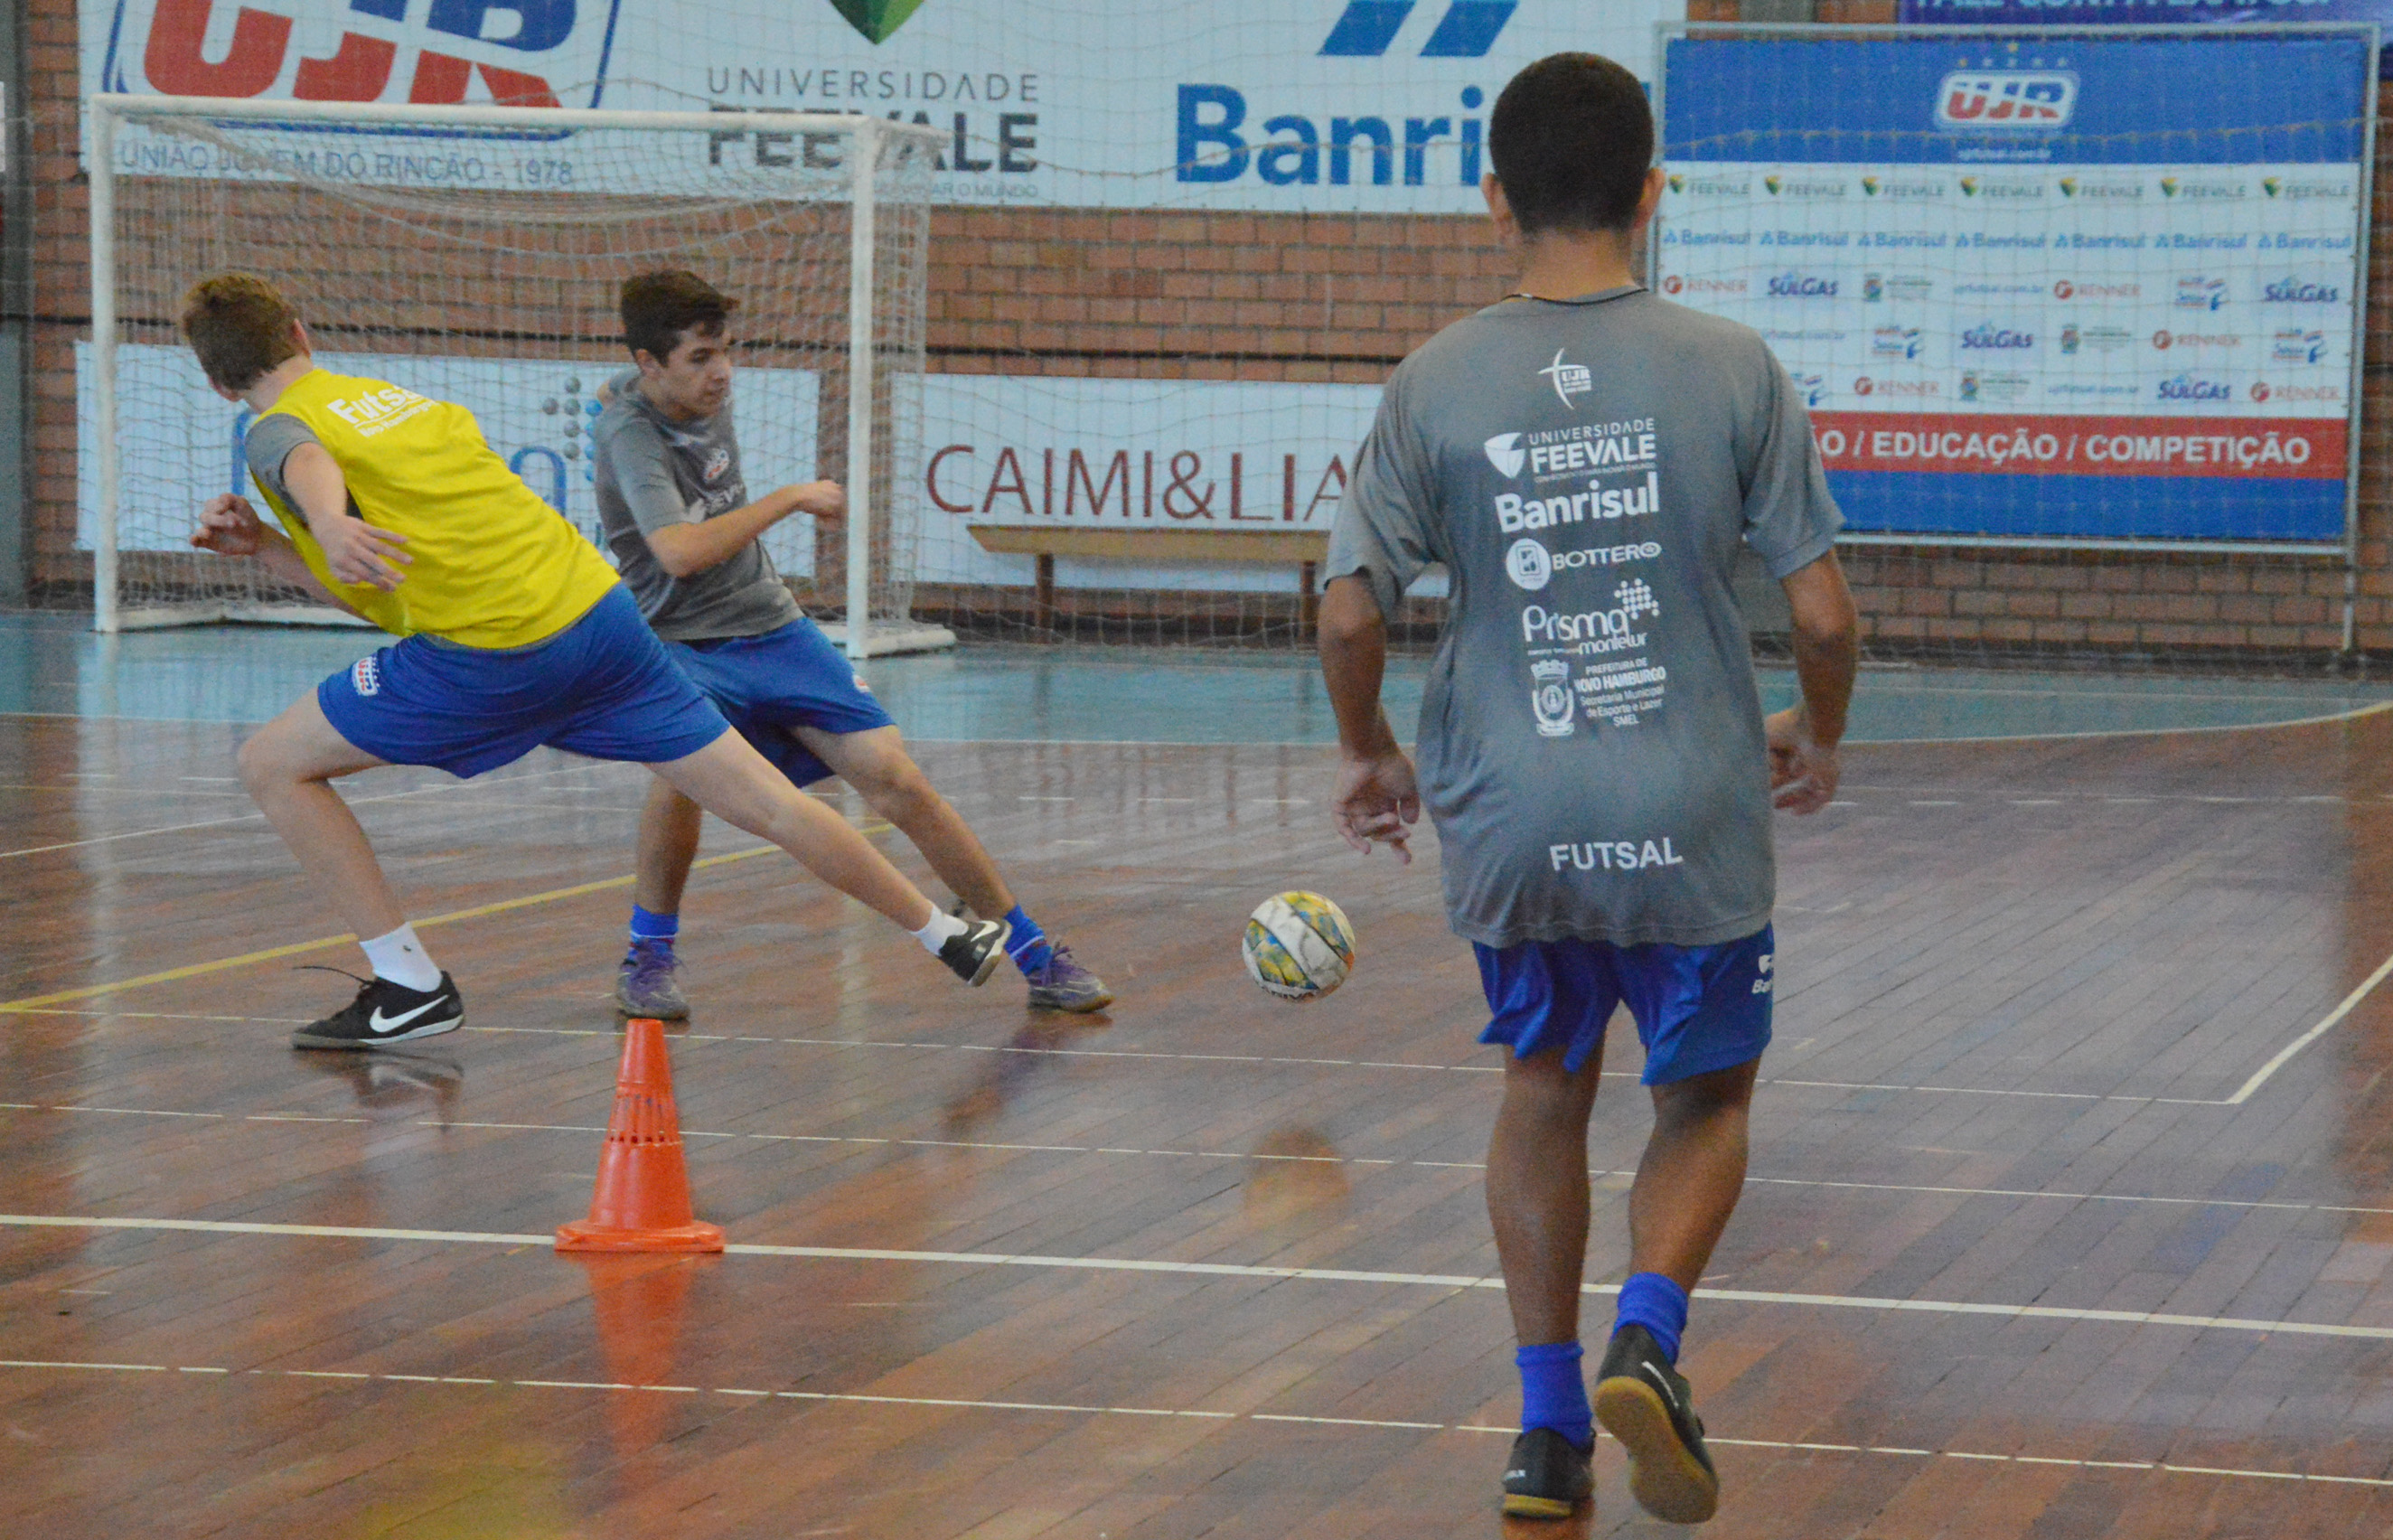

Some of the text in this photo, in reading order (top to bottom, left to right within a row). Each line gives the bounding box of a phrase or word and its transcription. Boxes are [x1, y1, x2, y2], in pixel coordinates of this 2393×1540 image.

[144, 0, 577, 108] UJR
[707, 67, 1039, 102] UNIVERSIDADE
[1947, 79, 2066, 119] UJR
[709, 103, 1039, 173] FEEALE
[1177, 82, 1485, 186] Banri
[324, 152, 367, 179] DO
[515, 158, 573, 183] 1978
[1681, 229, 1751, 245] Banrisul
[1777, 230, 1849, 247] Banrisul
[1874, 231, 1947, 248] Banrisul
[1973, 233, 2046, 249] Banrisul
[2072, 233, 2145, 249] Banrisul
[2173, 233, 2248, 249] Banrisul
[2276, 232, 2351, 249] Banrisul
[1527, 418, 1656, 446] UNIVERSIDADE
[1530, 434, 1656, 474] FEEVALE
[1873, 427, 2060, 466] EDUCAÇÃO
[2086, 431, 2311, 471] COMPETIÇÃO
[926, 444, 1347, 522] CAIMI&LIA
[1494, 471, 1659, 533] Banrisul
[1551, 541, 1662, 570] BOTTERO
[1522, 605, 1629, 642] Prisma
[1573, 665, 1666, 692] NOVO HAMBURGO
[1549, 836, 1684, 872] FUTSAL
